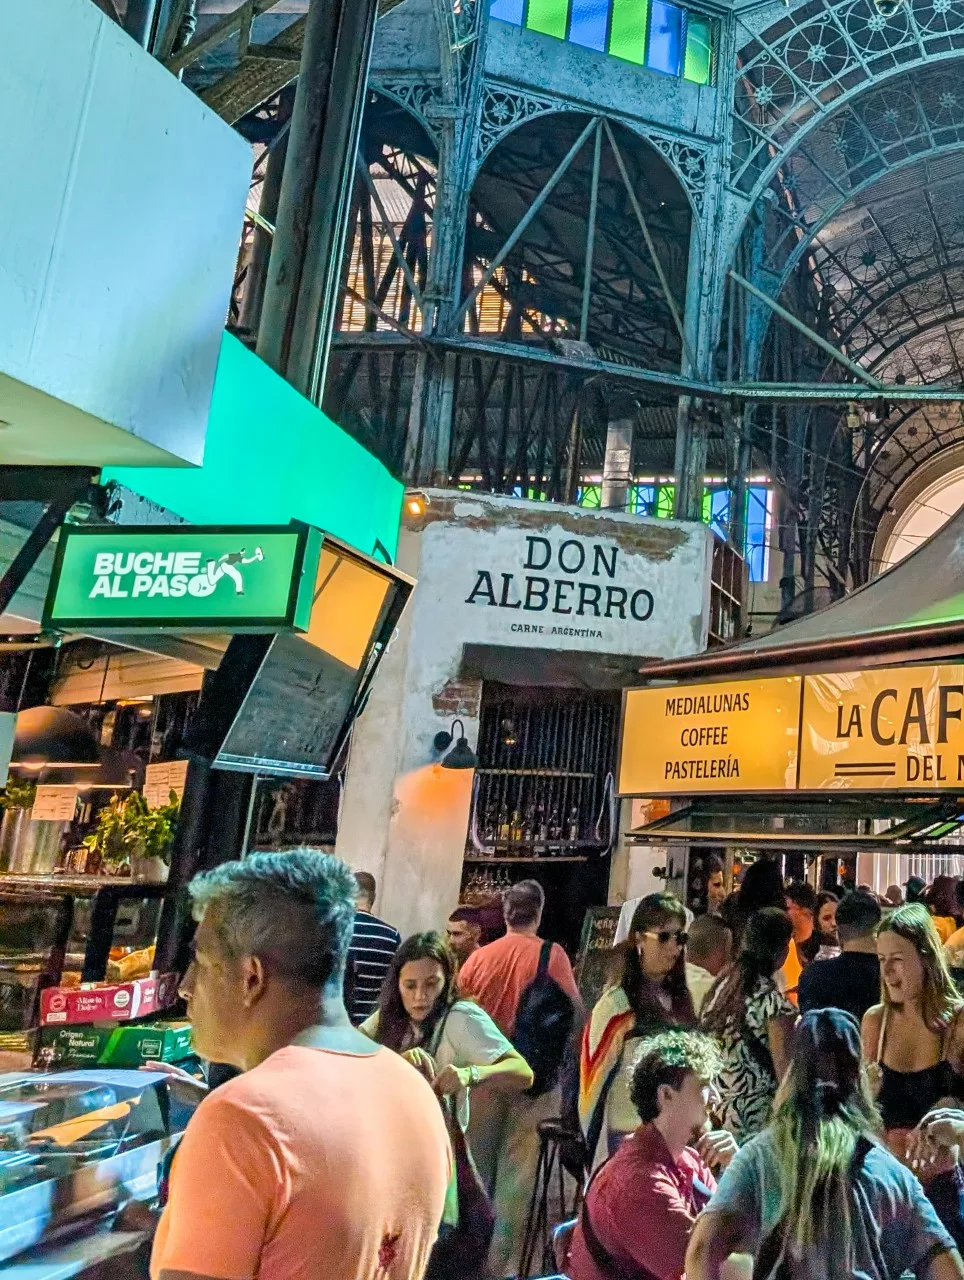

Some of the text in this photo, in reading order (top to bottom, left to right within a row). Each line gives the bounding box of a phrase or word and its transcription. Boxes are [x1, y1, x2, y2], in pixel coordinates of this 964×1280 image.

[93, 551, 202, 576] BUCHE
[523, 535, 619, 579] DON
[88, 574, 217, 598] AL PASO
[464, 570, 655, 621] ALBERRO
[510, 623, 544, 634] CARNE
[665, 692, 750, 717] MEDIALUNAS
[835, 704, 864, 739] LA
[680, 726, 729, 747] COFFEE
[664, 753, 740, 780] PASTELERÍA
[906, 754, 947, 782] DEL
[69, 1039, 95, 1047] Natural
